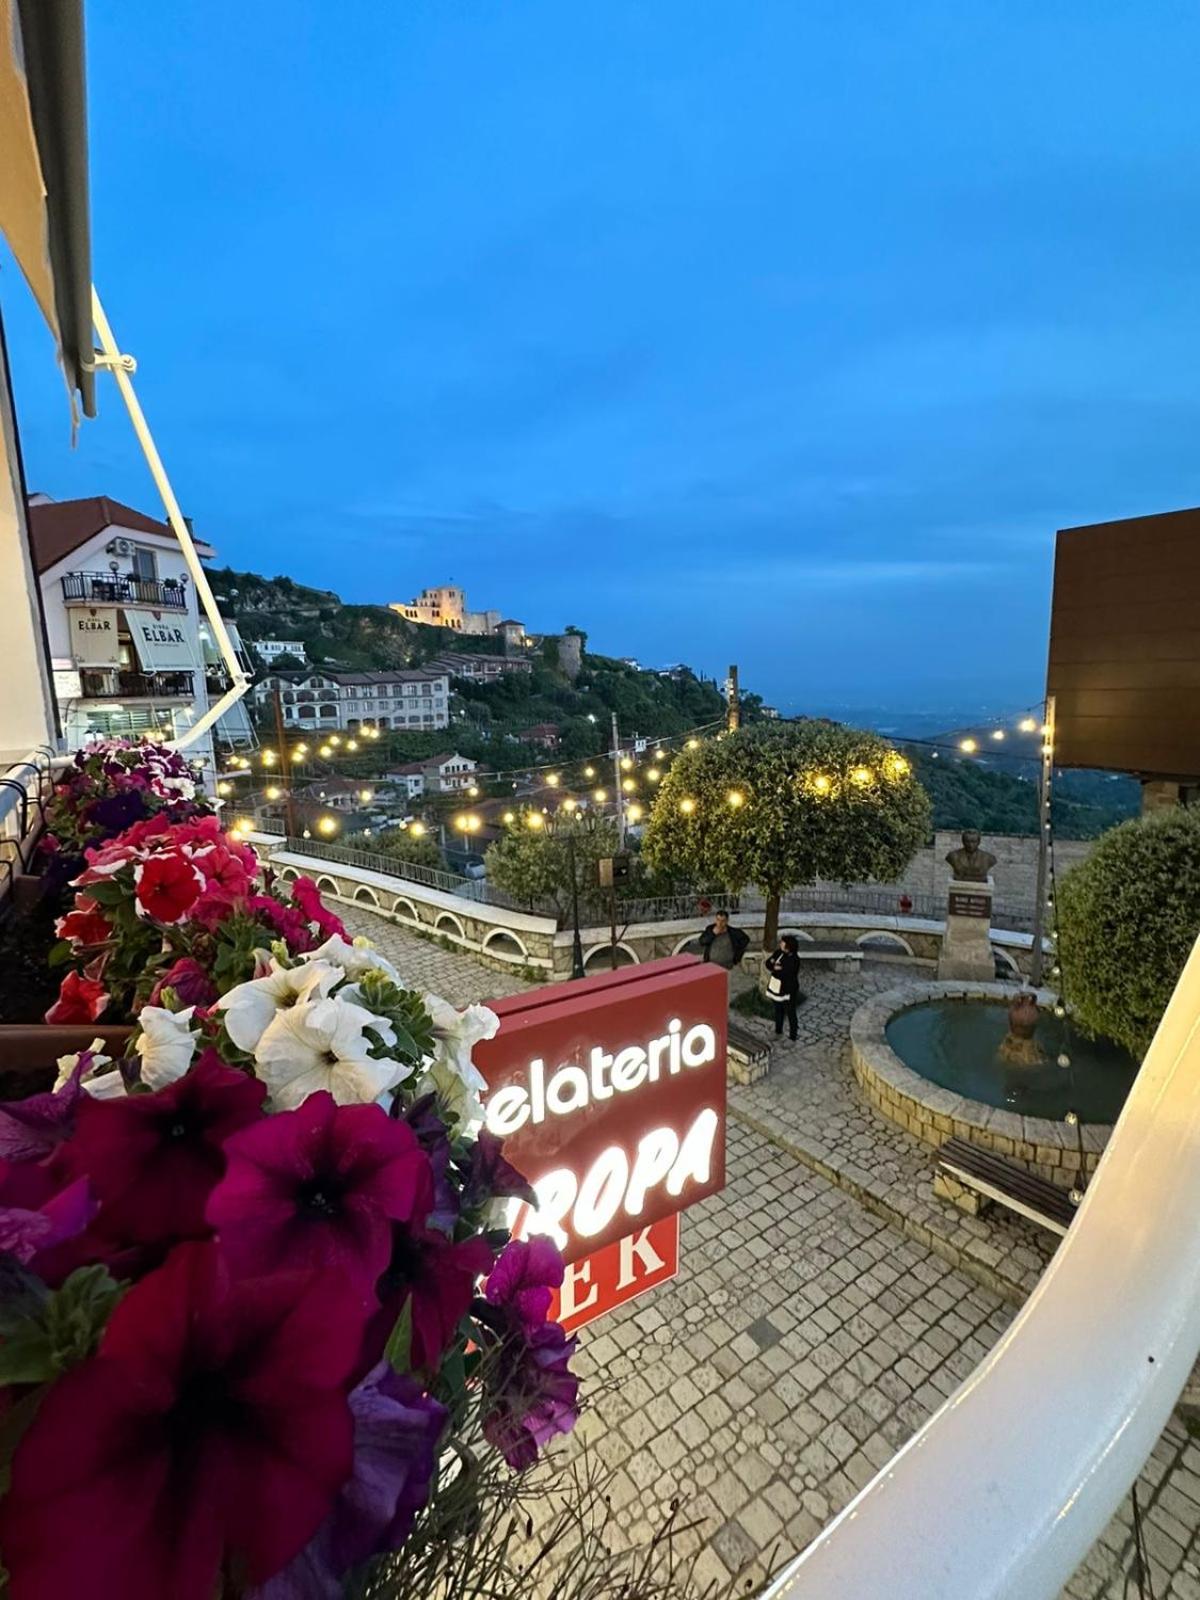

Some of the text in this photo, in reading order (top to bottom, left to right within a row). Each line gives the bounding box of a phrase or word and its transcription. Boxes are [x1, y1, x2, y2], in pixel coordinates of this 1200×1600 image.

[78, 621, 111, 630] ELBAR
[142, 627, 185, 643] ELBAR
[464, 1018, 715, 1136] elateria
[506, 1108, 718, 1251] ROPA
[556, 1224, 665, 1323] EK
